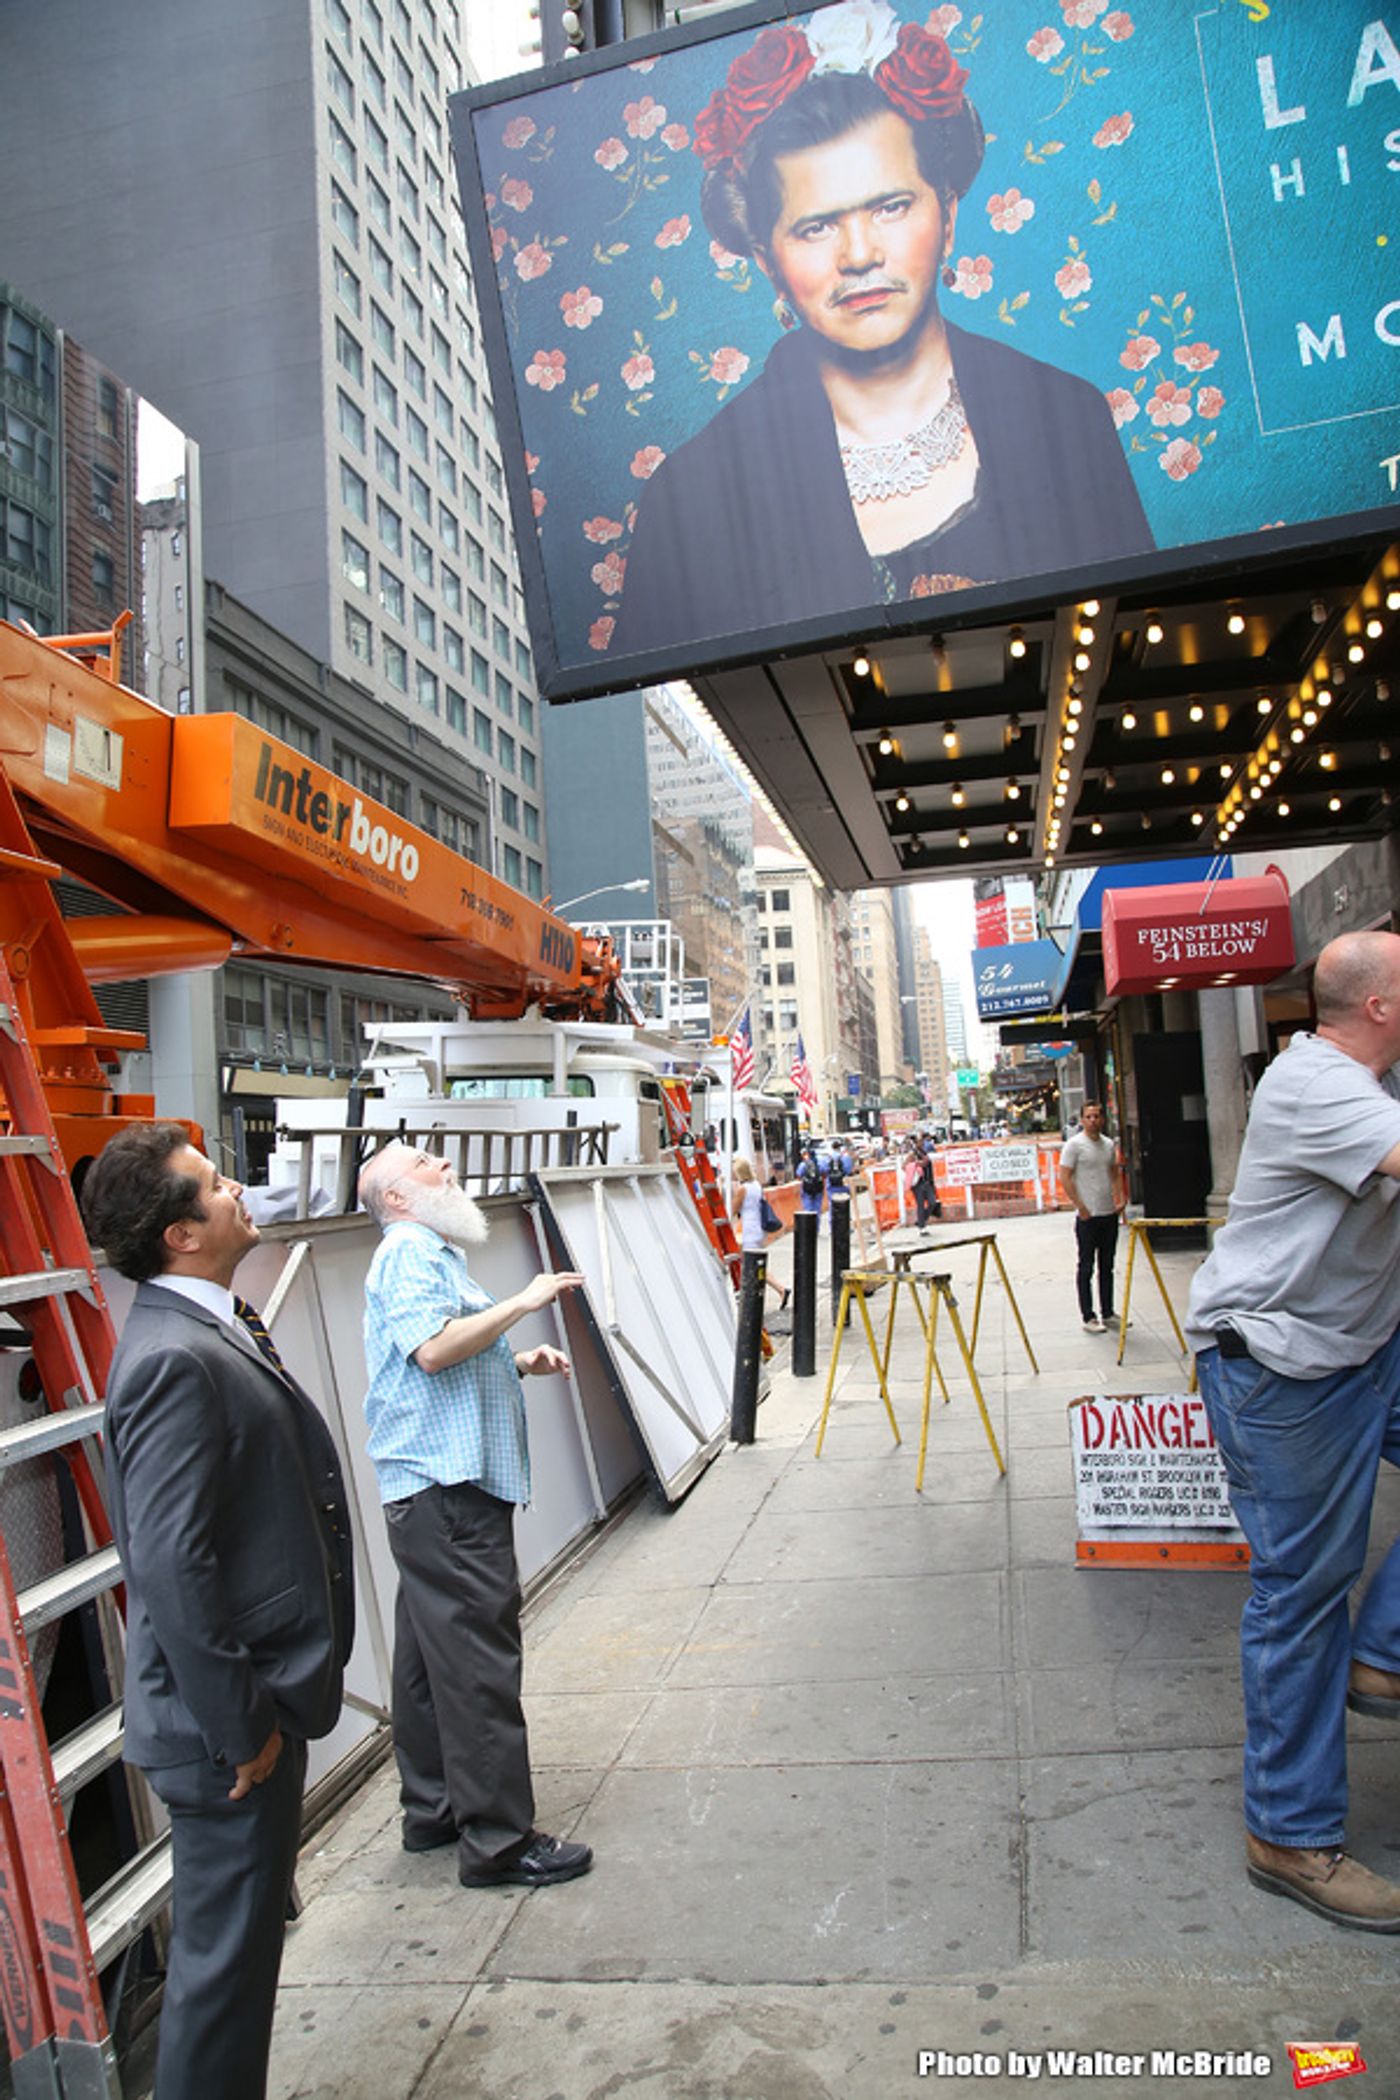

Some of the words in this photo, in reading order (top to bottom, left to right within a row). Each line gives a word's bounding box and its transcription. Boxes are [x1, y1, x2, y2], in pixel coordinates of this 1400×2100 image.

[254, 741, 419, 882] Interboro
[1138, 918, 1268, 944] FEINSTEIN'S/
[1152, 941, 1180, 963] 54
[1185, 939, 1256, 958] BELOW
[980, 963, 1014, 981] 54
